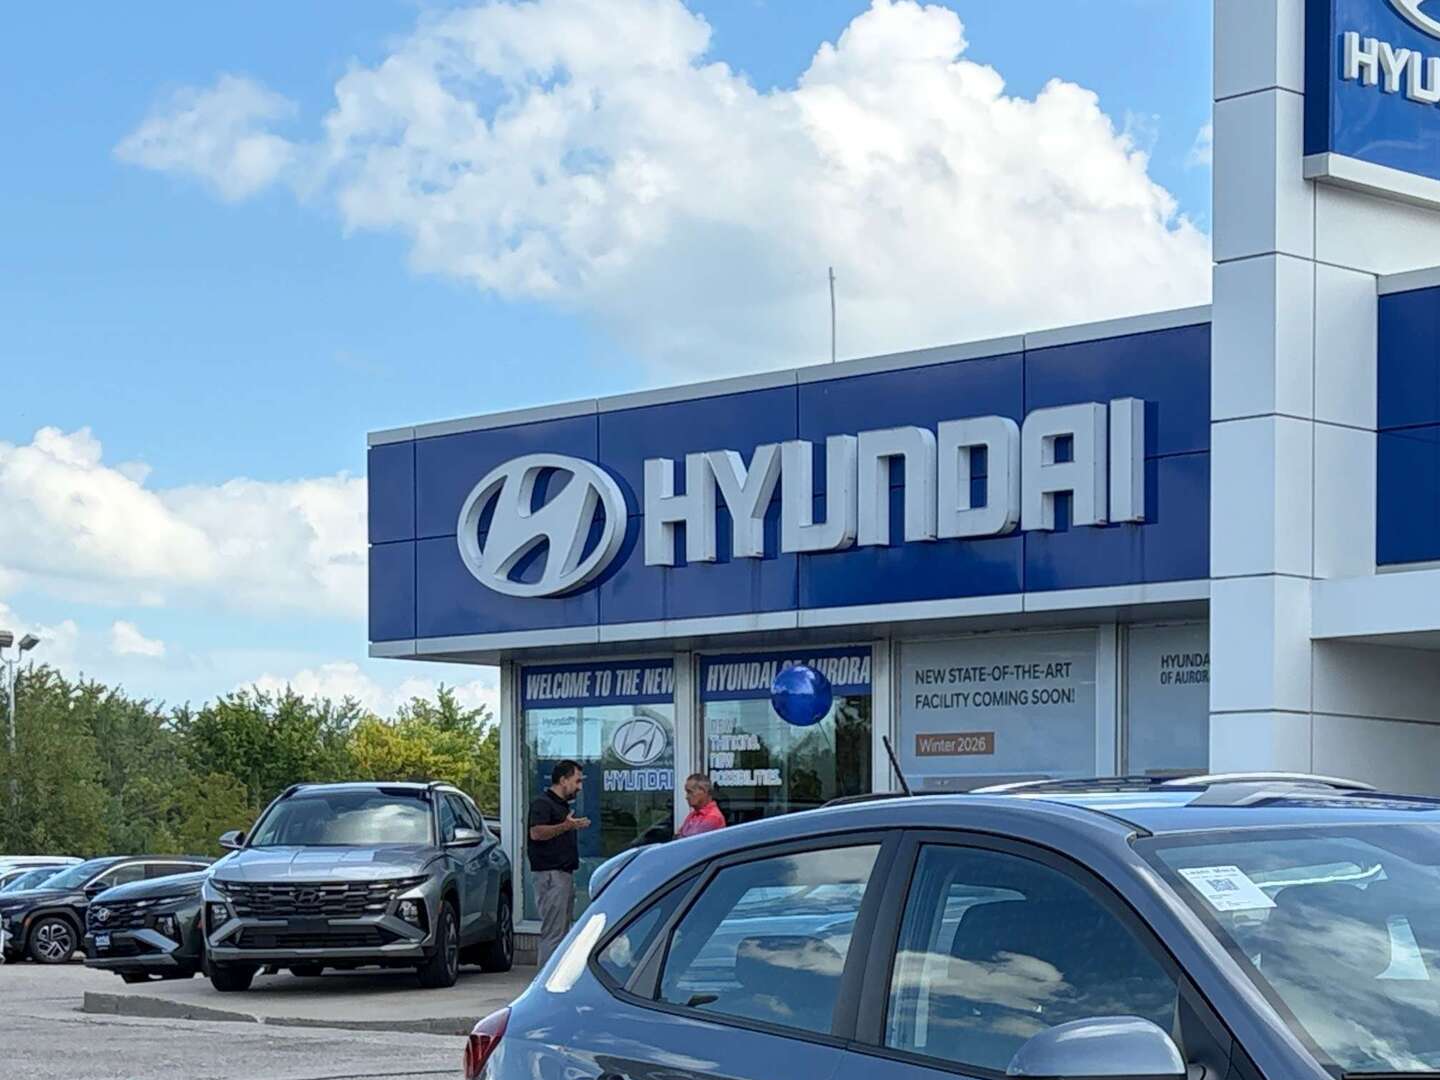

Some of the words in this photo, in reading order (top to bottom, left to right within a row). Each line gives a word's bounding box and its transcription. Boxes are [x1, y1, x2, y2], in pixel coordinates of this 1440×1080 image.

[644, 397, 1145, 567] HYUNDAI
[526, 671, 592, 700] WELCOME
[595, 670, 612, 697] TO
[616, 668, 641, 696] THE
[642, 667, 674, 695] NEW
[706, 660, 777, 692] HYUNDAI
[915, 669, 945, 685] NEW
[948, 662, 1072, 684] STATE-OF-THE-ART
[1160, 671, 1173, 685] OF
[915, 691, 970, 710] FACILITY
[972, 690, 1028, 708] COMING
[1031, 688, 1075, 705] SOON!
[920, 739, 955, 753] Winter
[957, 737, 986, 752] 2026
[603, 768, 674, 792] HYUNDAI
